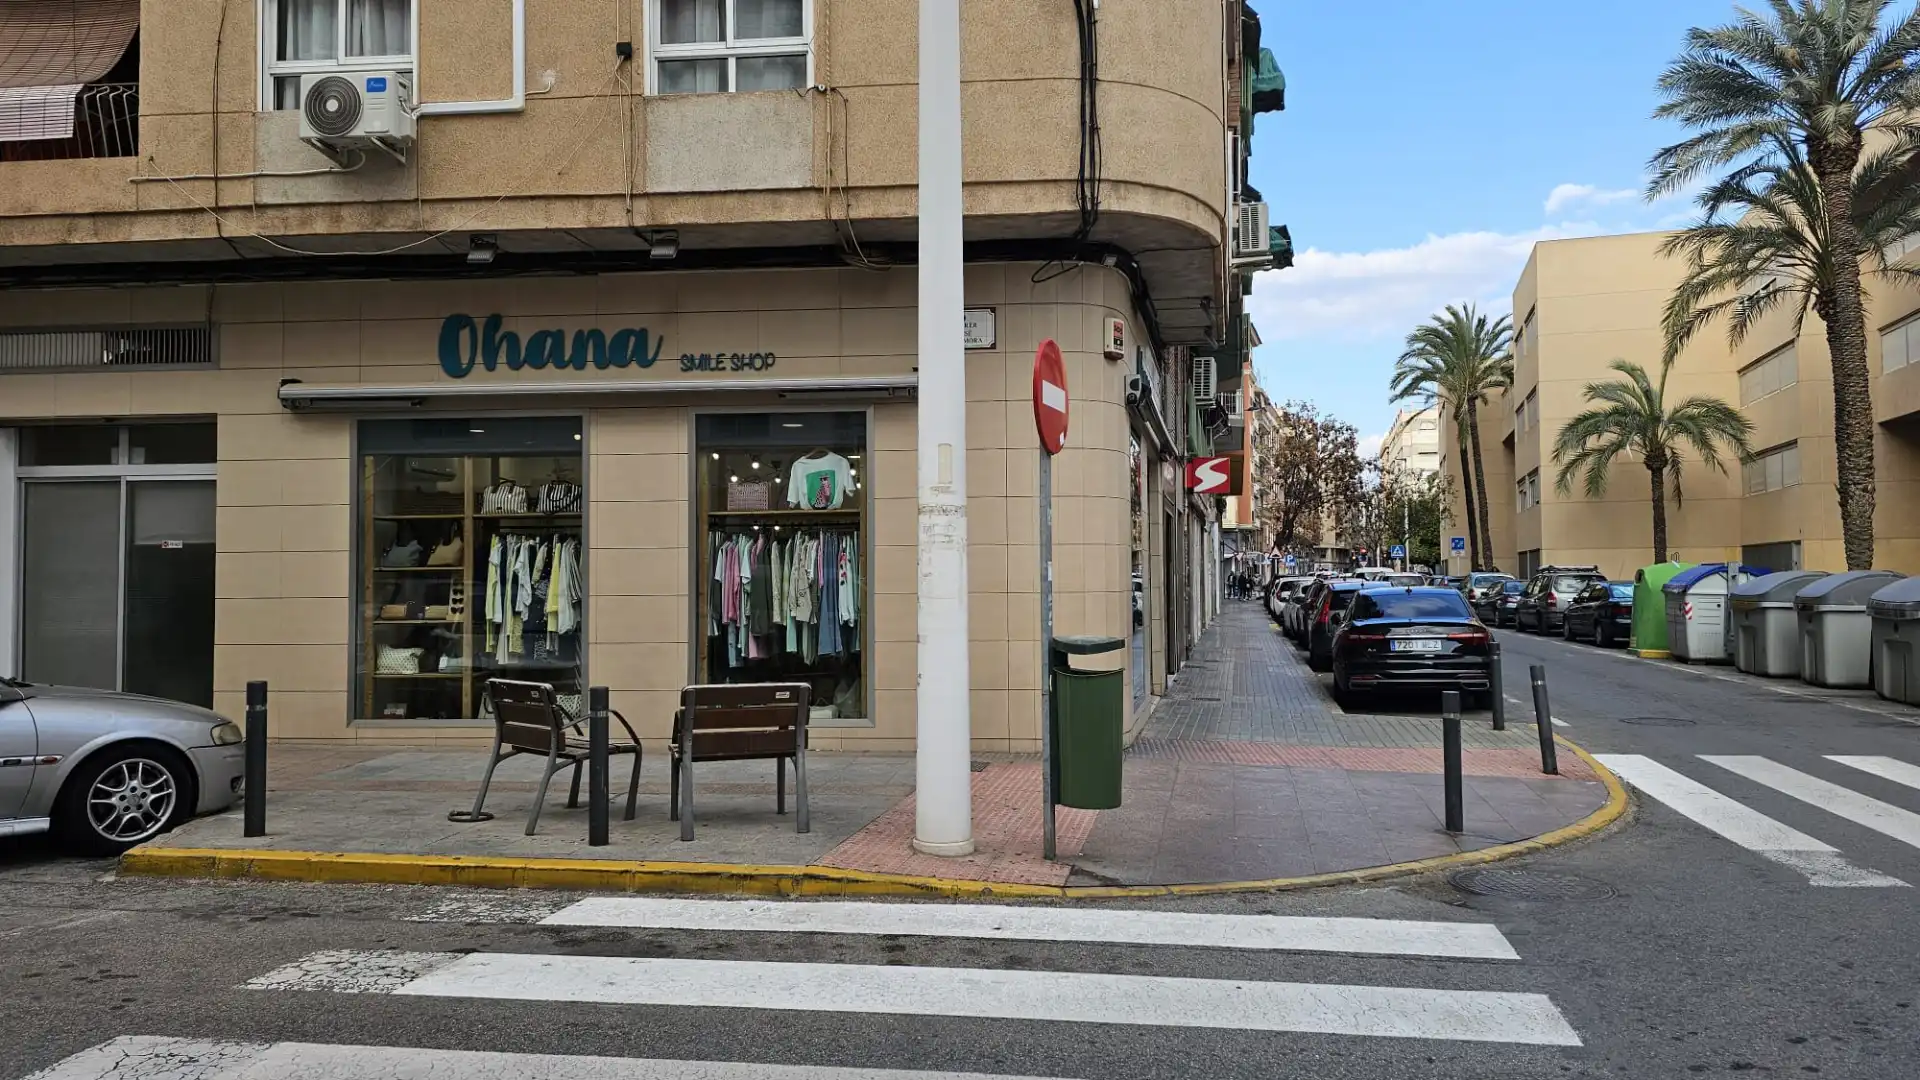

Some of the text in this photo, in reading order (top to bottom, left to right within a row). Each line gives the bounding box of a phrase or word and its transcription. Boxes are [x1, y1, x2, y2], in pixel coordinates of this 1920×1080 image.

[438, 313, 664, 379] Ohana
[680, 352, 776, 373] SMILE SHOP
